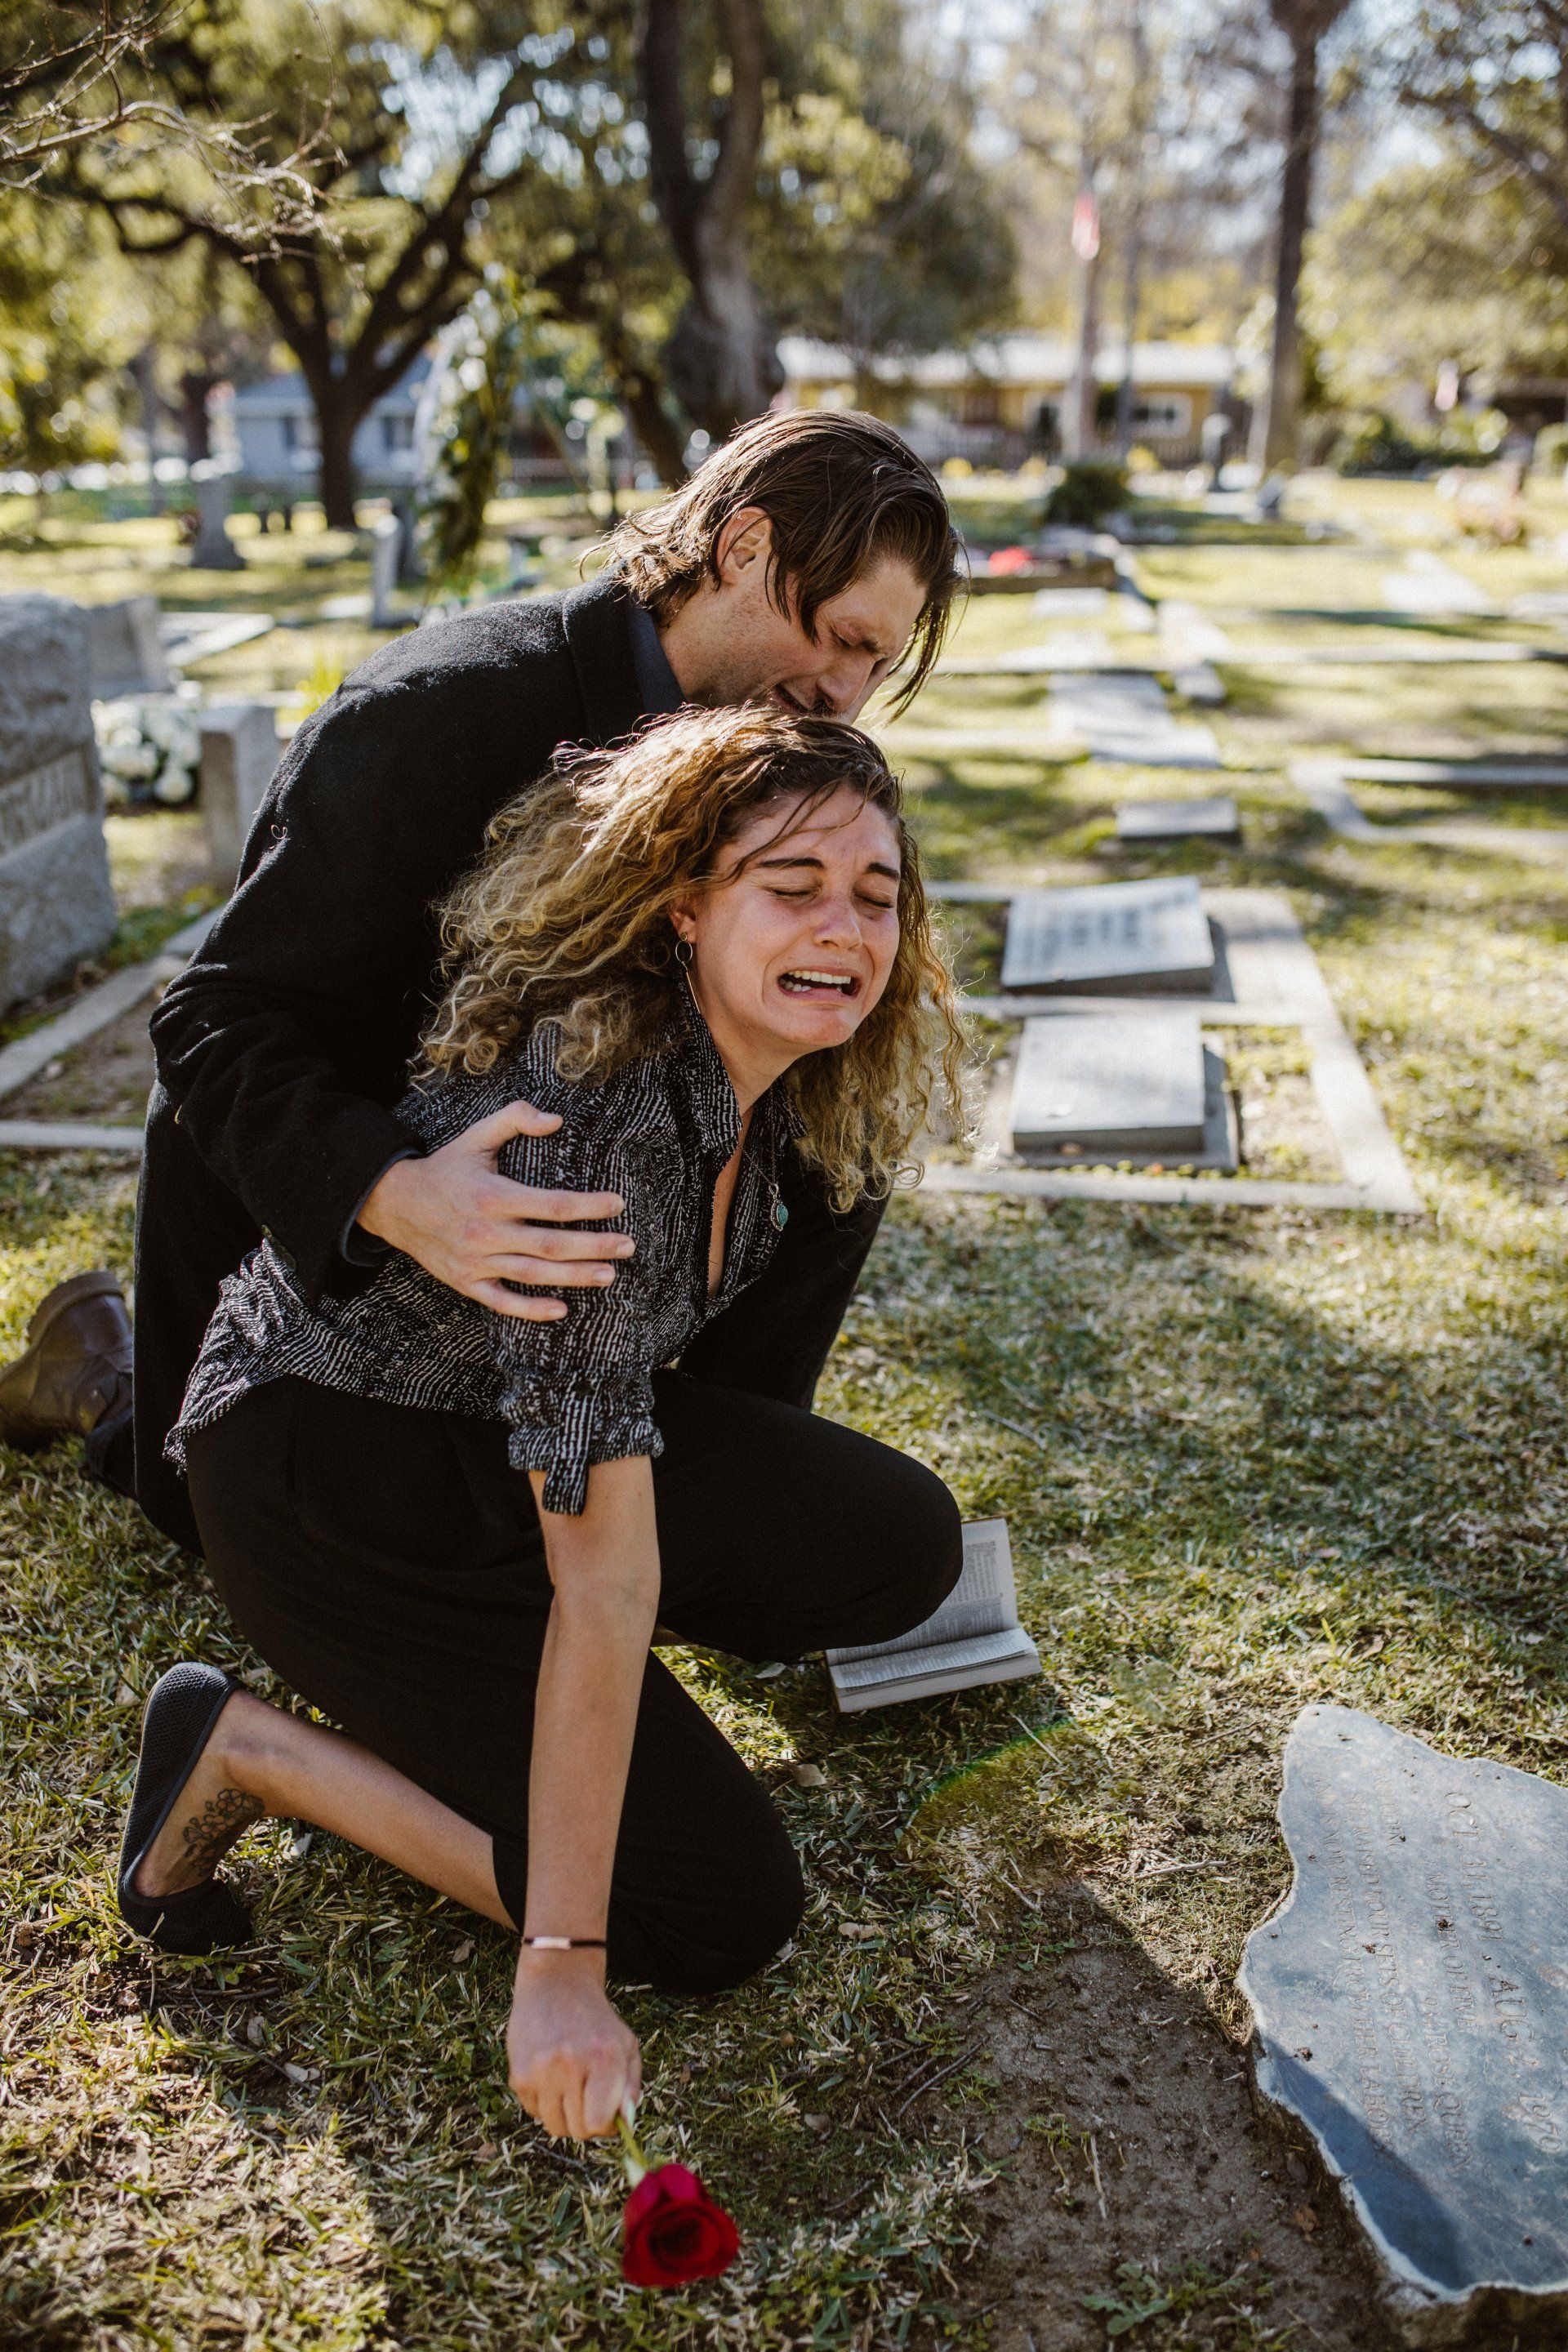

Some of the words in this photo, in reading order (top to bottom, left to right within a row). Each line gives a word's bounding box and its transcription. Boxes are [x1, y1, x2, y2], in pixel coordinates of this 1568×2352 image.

[1322, 1829, 1346, 1870] NOW
[1352, 1826, 1380, 1885] RAISED
[1329, 1876, 1361, 1953] RESTING
[1363, 1891, 1390, 1940] FOUR
[1427, 1872, 1459, 1949] MOTHER
[1443, 1955, 1468, 1980] OF
[1470, 1893, 1503, 1940] 1891
[1343, 1957, 1372, 2011] FROM
[1374, 1944, 1400, 1986] SETS
[1382, 1992, 1407, 2017] OF
[1354, 2018, 1379, 2058] HER
[1425, 2033, 1456, 2087] ROSE
[1389, 2023, 1429, 2133] CHILDREN
[1433, 2091, 1472, 2175] QUEEN
